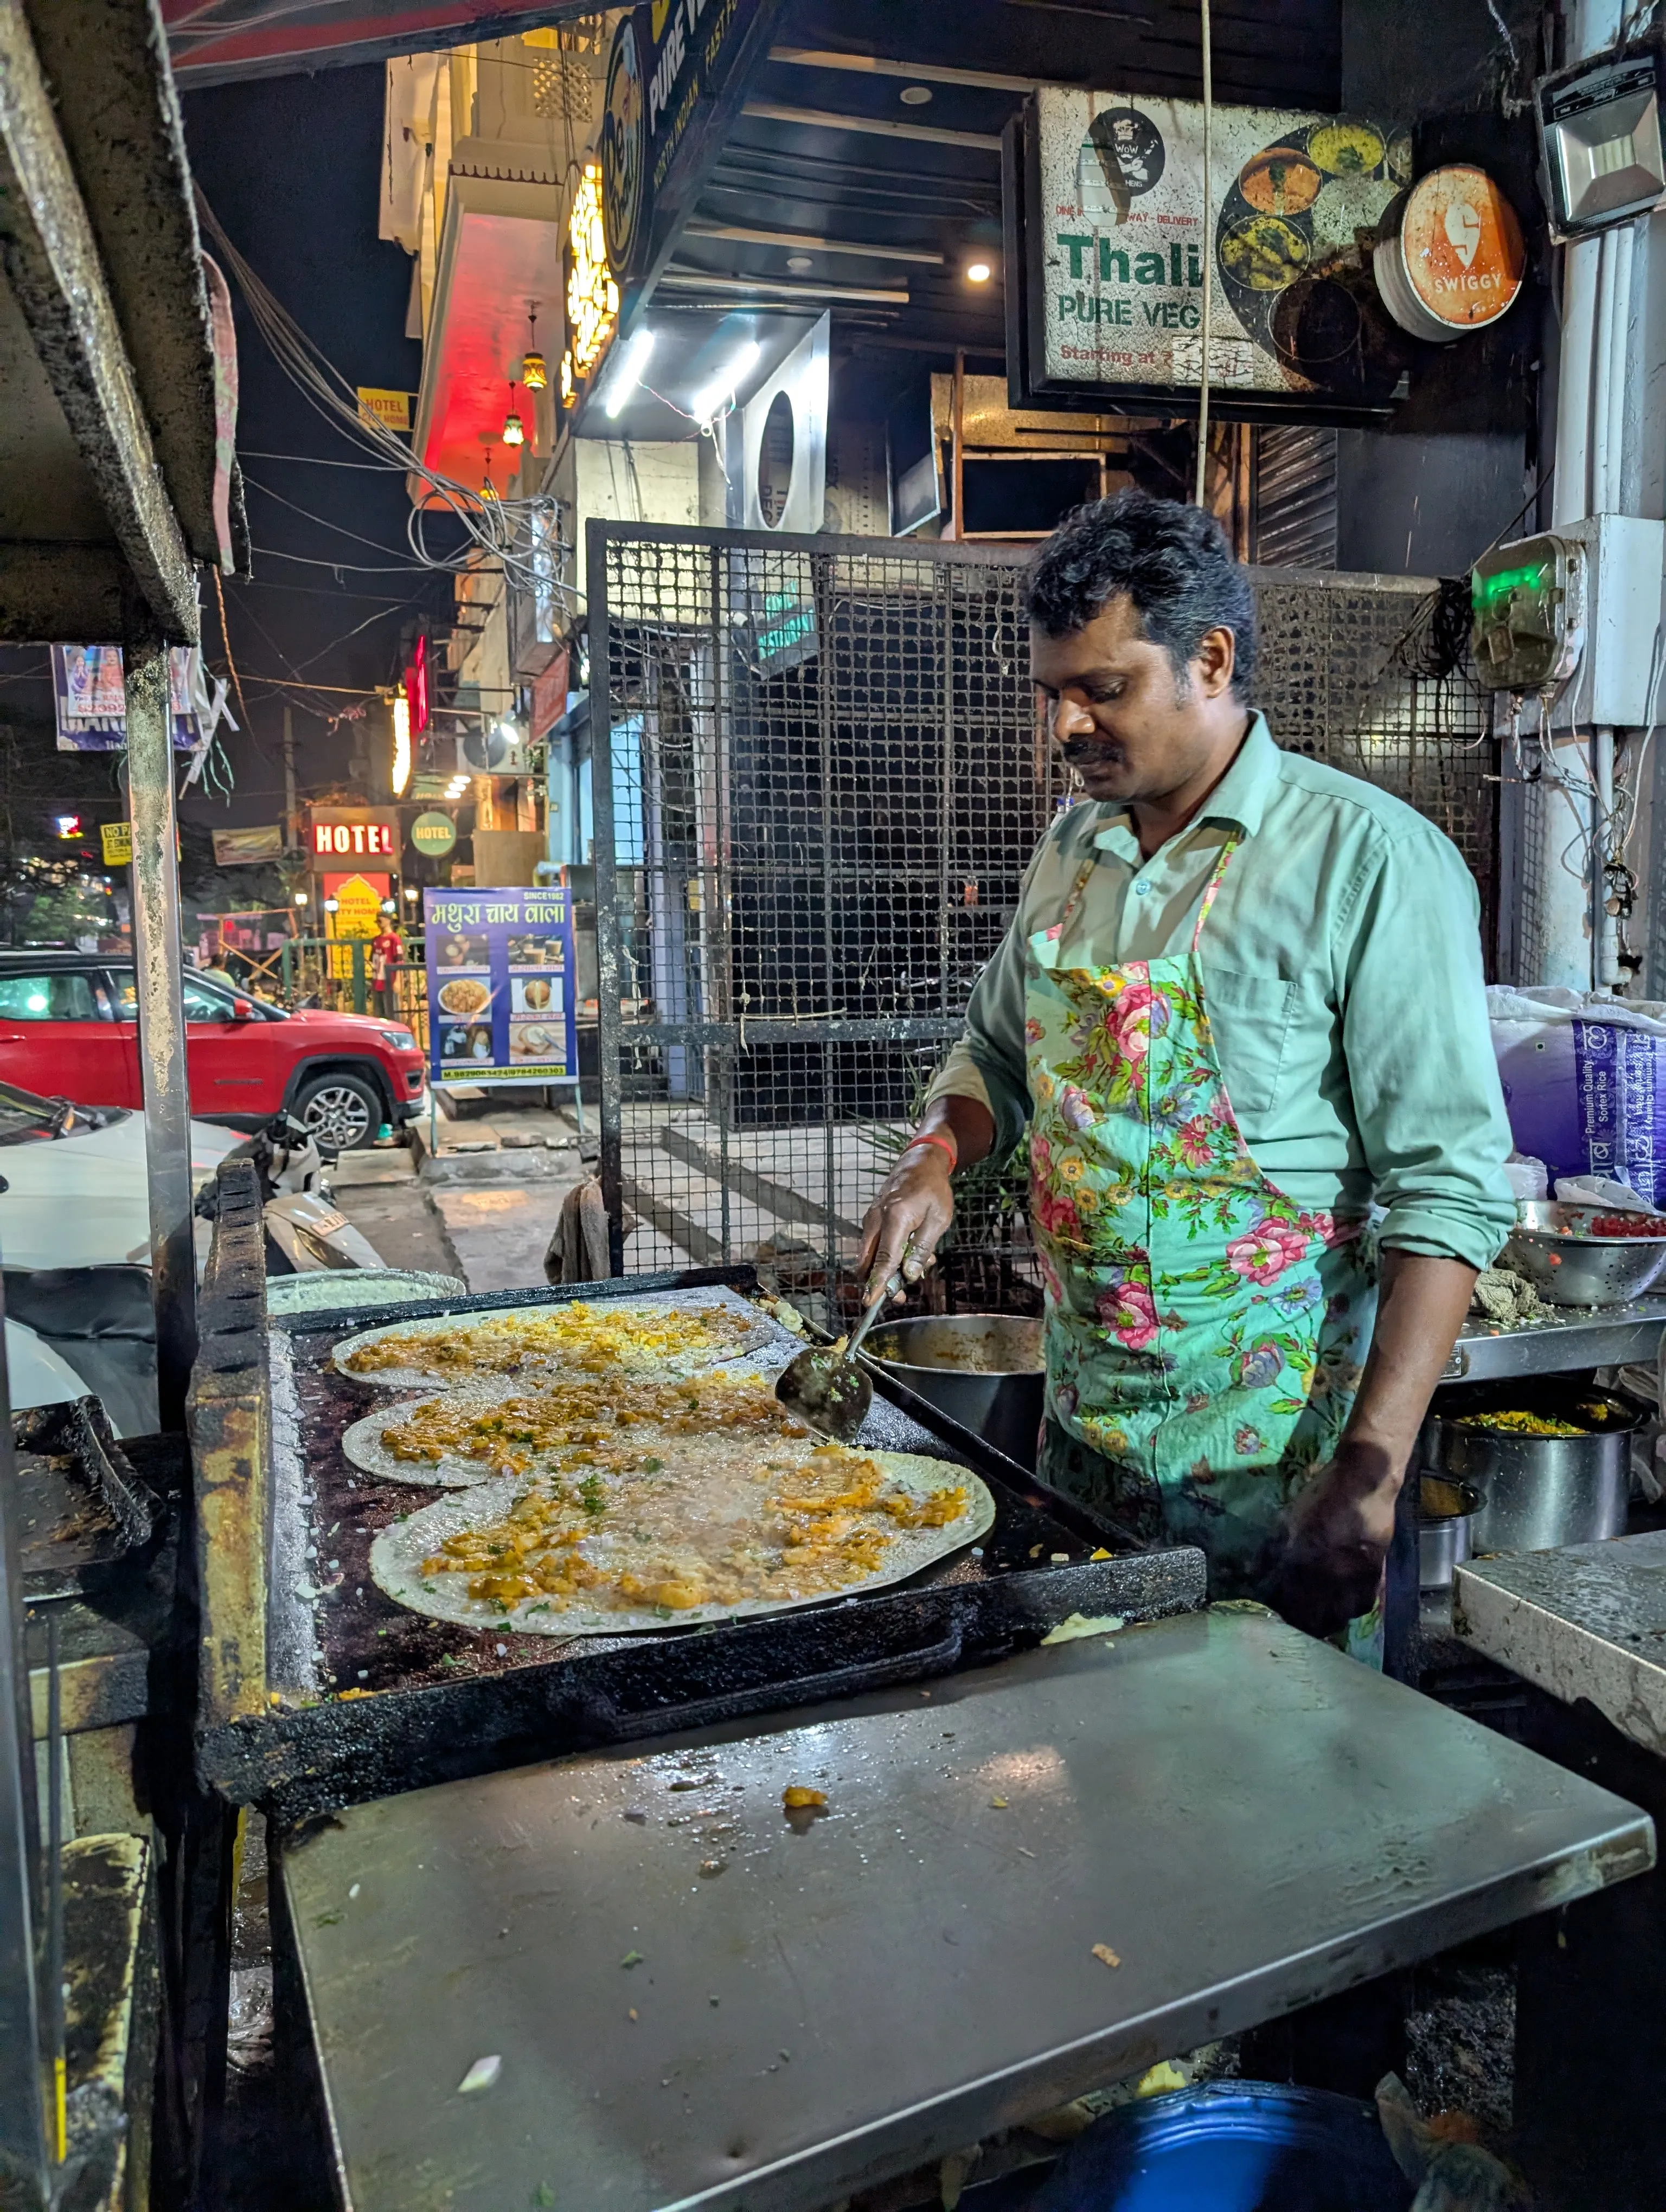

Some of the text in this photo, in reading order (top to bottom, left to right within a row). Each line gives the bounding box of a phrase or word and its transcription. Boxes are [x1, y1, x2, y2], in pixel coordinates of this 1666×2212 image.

[1157, 213, 1198, 226] DELIVERY
[1057, 233, 1201, 287] Thali
[1434, 273, 1502, 293] SWIGGY
[1059, 295, 1201, 330] PURE VEG
[1060, 345, 1133, 366] Starting
[1138, 351, 1155, 364] at
[366, 398, 403, 412] HOTEL
[316, 825, 393, 853] HOTEL
[416, 826, 451, 839] HOTEL
[431, 903, 566, 933] मथुरा चाय वाला
[1582, 1060, 1595, 1134] Premium Quality
[1598, 1071, 1608, 1122] Sortex Rice
